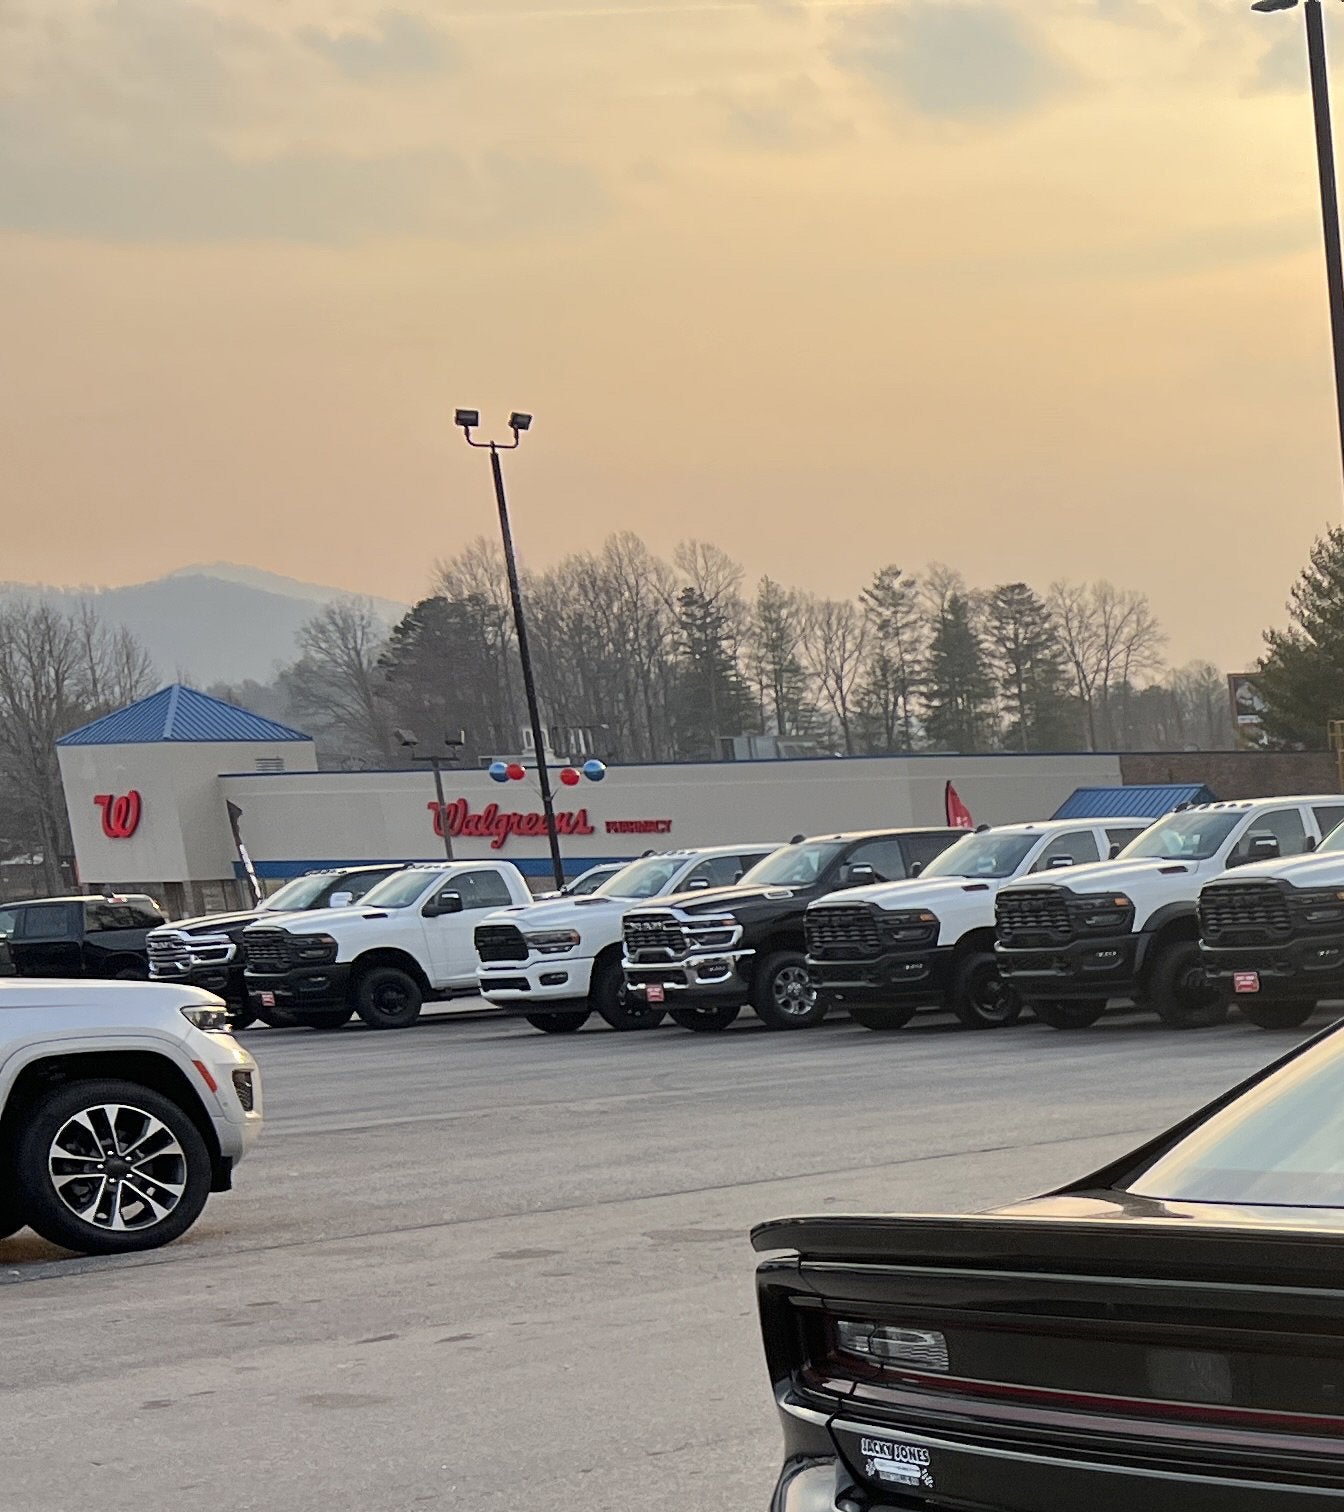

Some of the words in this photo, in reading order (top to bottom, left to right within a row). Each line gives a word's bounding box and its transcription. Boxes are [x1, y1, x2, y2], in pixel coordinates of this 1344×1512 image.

[94, 790, 141, 838] W
[861, 1438, 892, 1459] JACKY
[894, 1444, 930, 1466] JONES
